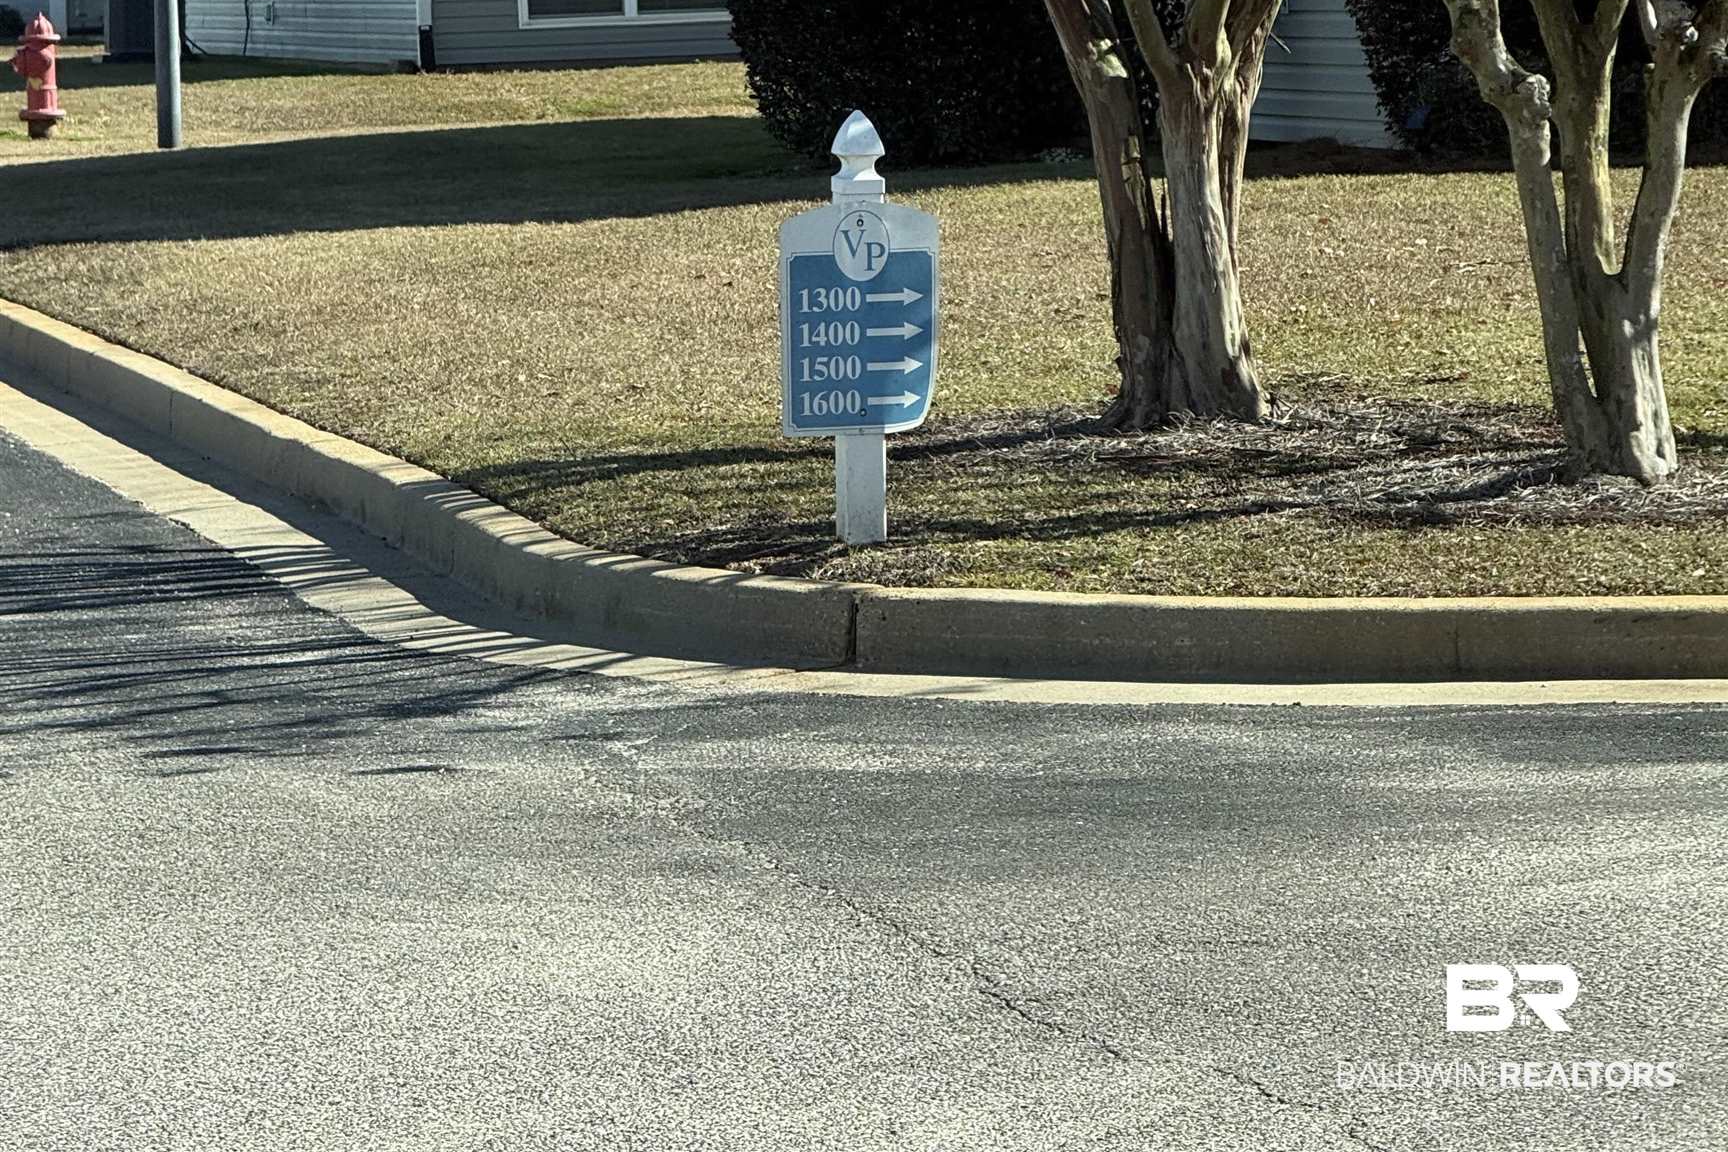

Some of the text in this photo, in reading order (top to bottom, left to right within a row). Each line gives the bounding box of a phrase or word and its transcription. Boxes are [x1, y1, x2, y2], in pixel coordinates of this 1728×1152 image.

[840, 229, 886, 272] VP
[798, 286, 862, 313] 1300
[798, 320, 861, 347] 1400
[799, 355, 862, 382] 1500
[799, 389, 862, 416] 1600
